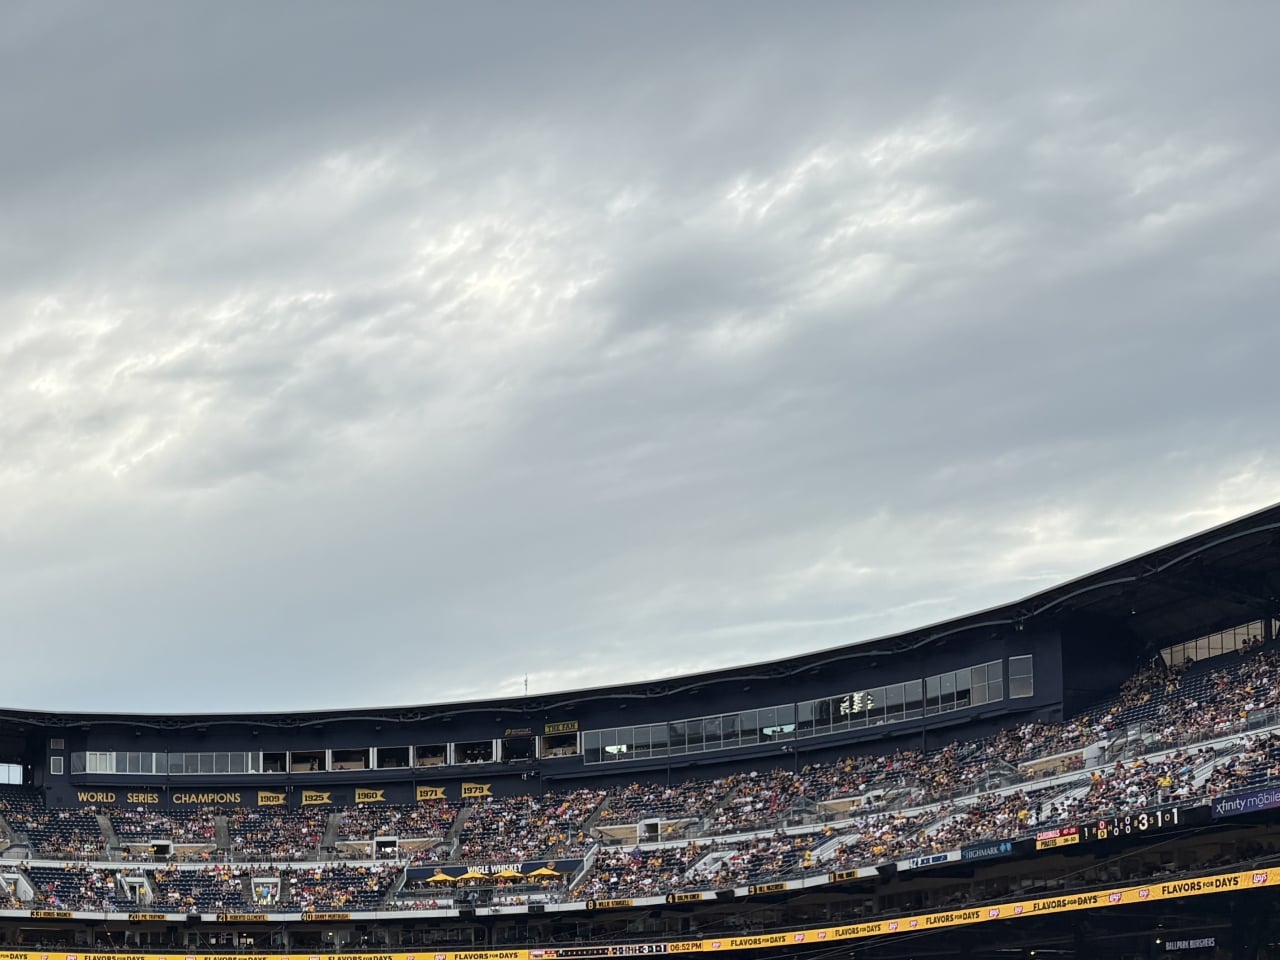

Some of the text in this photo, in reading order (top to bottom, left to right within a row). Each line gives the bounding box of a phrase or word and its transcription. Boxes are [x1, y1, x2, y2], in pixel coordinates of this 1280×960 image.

[419, 789, 437, 797] 1971
[463, 786, 484, 794] 1979
[77, 792, 241, 804] WORLD SERIES CHAMPIONS
[261, 795, 280, 803] 1909
[1216, 798, 1245, 814] xfinity
[1139, 814, 1148, 831] 3
[1156, 811, 1162, 827] 1
[1172, 808, 1178, 824] 1
[467, 863, 523, 874] WIGLE WHISKEY
[1162, 881, 1202, 895] FLAVORS
[1215, 876, 1239, 888] DAYS
[1033, 898, 1067, 911] FLAVORS
[1077, 894, 1098, 906] DAYS
[925, 914, 954, 926] FLAVORS
[962, 910, 981, 921] DAYS
[835, 927, 859, 937] FLAVORS
[867, 924, 881, 933] DAYS
[730, 937, 762, 947] FLAVORS
[670, 944, 690, 952] 06:52
[454, 953, 489, 960] FLAVORS
